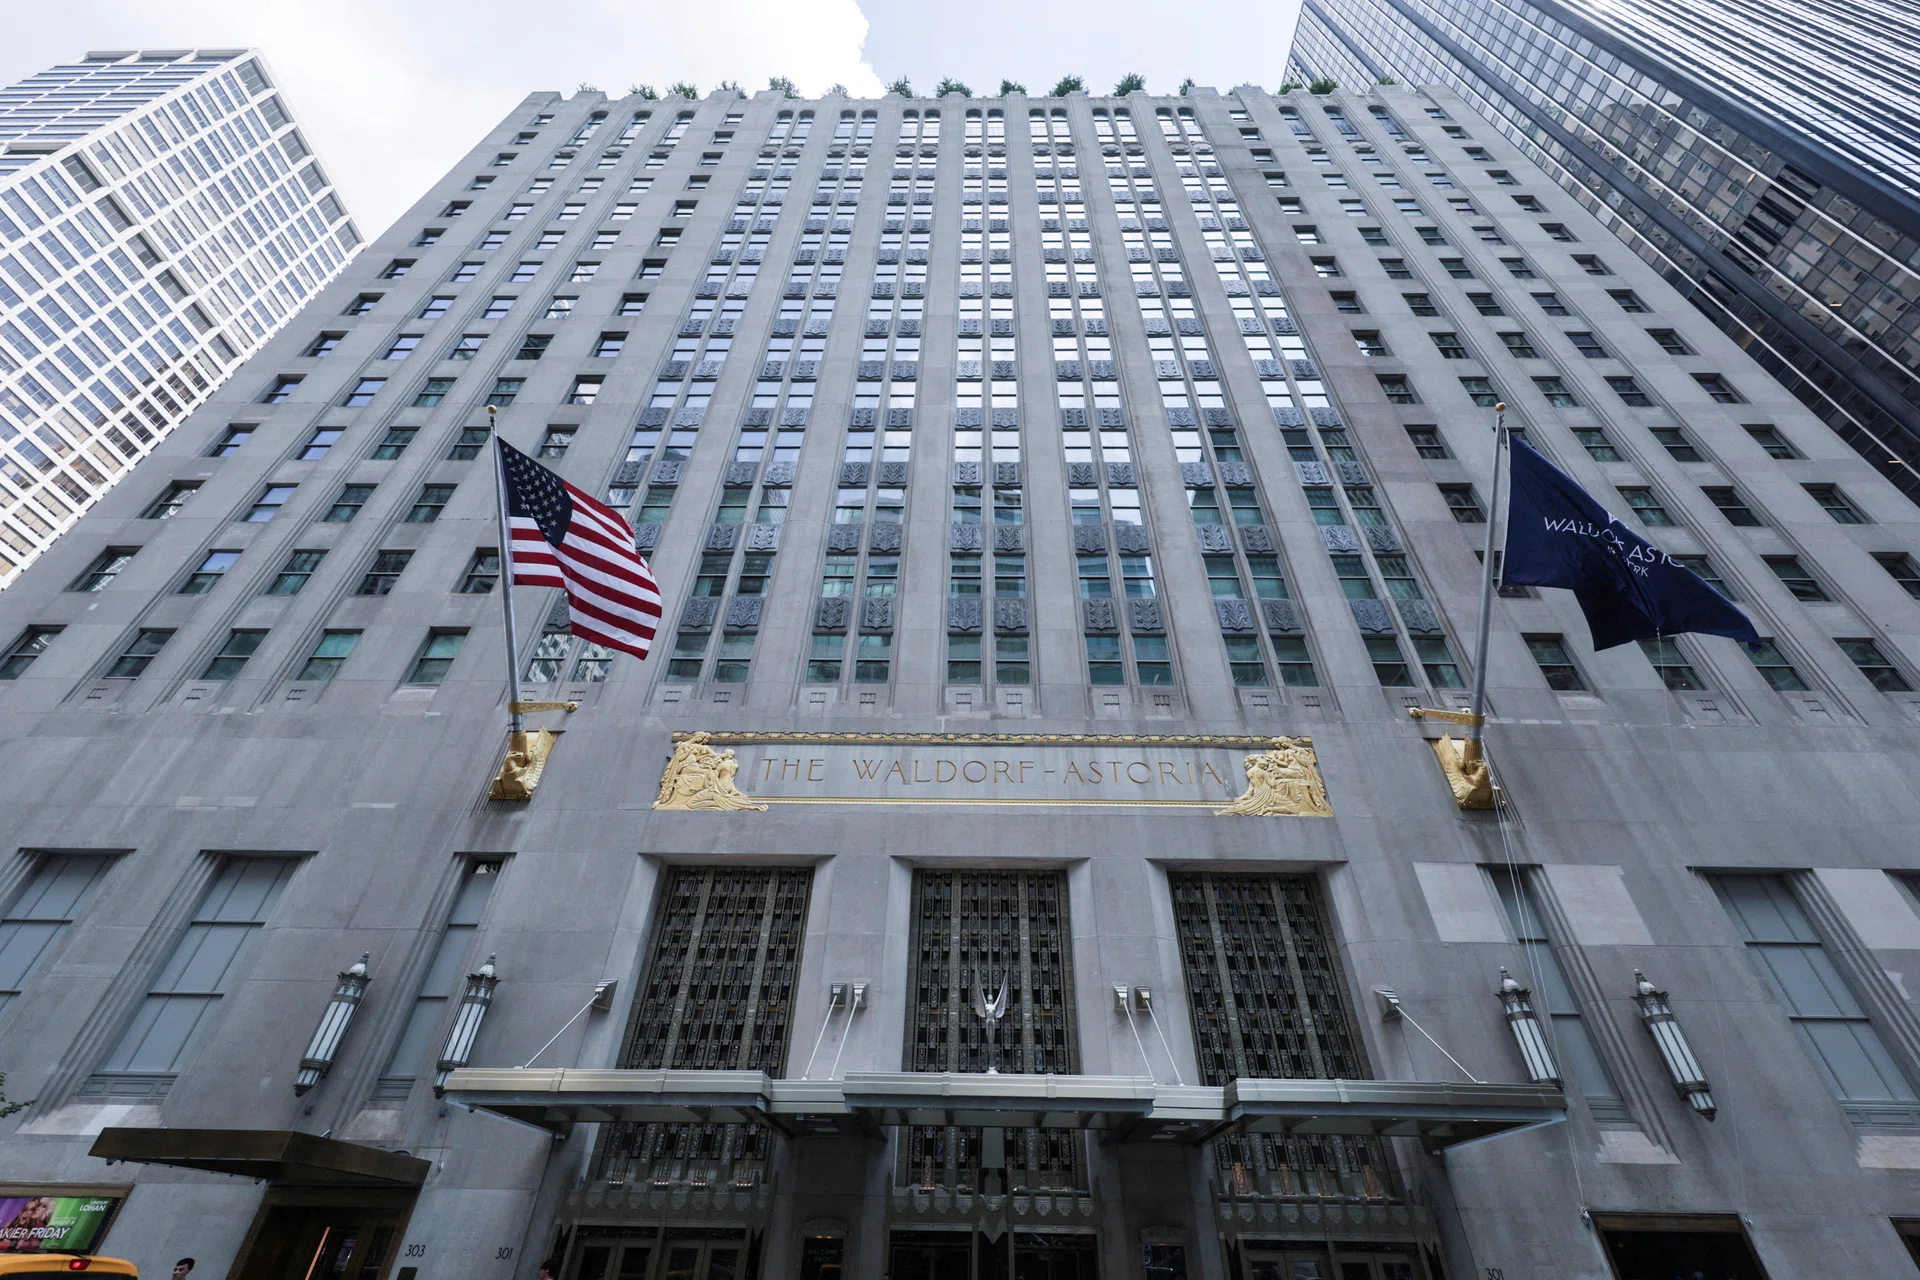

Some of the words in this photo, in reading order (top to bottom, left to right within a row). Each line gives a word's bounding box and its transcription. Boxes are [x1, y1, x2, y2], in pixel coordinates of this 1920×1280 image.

[762, 758, 825, 782] THE
[852, 759, 1224, 785] WALDORF-ASTORIA
[78, 1204, 106, 1212] LOHAN
[26, 1227, 71, 1240] FRIDAY
[404, 1244, 426, 1257] 303
[494, 1247, 514, 1260] 301
[1485, 1267, 1505, 1280] 301
